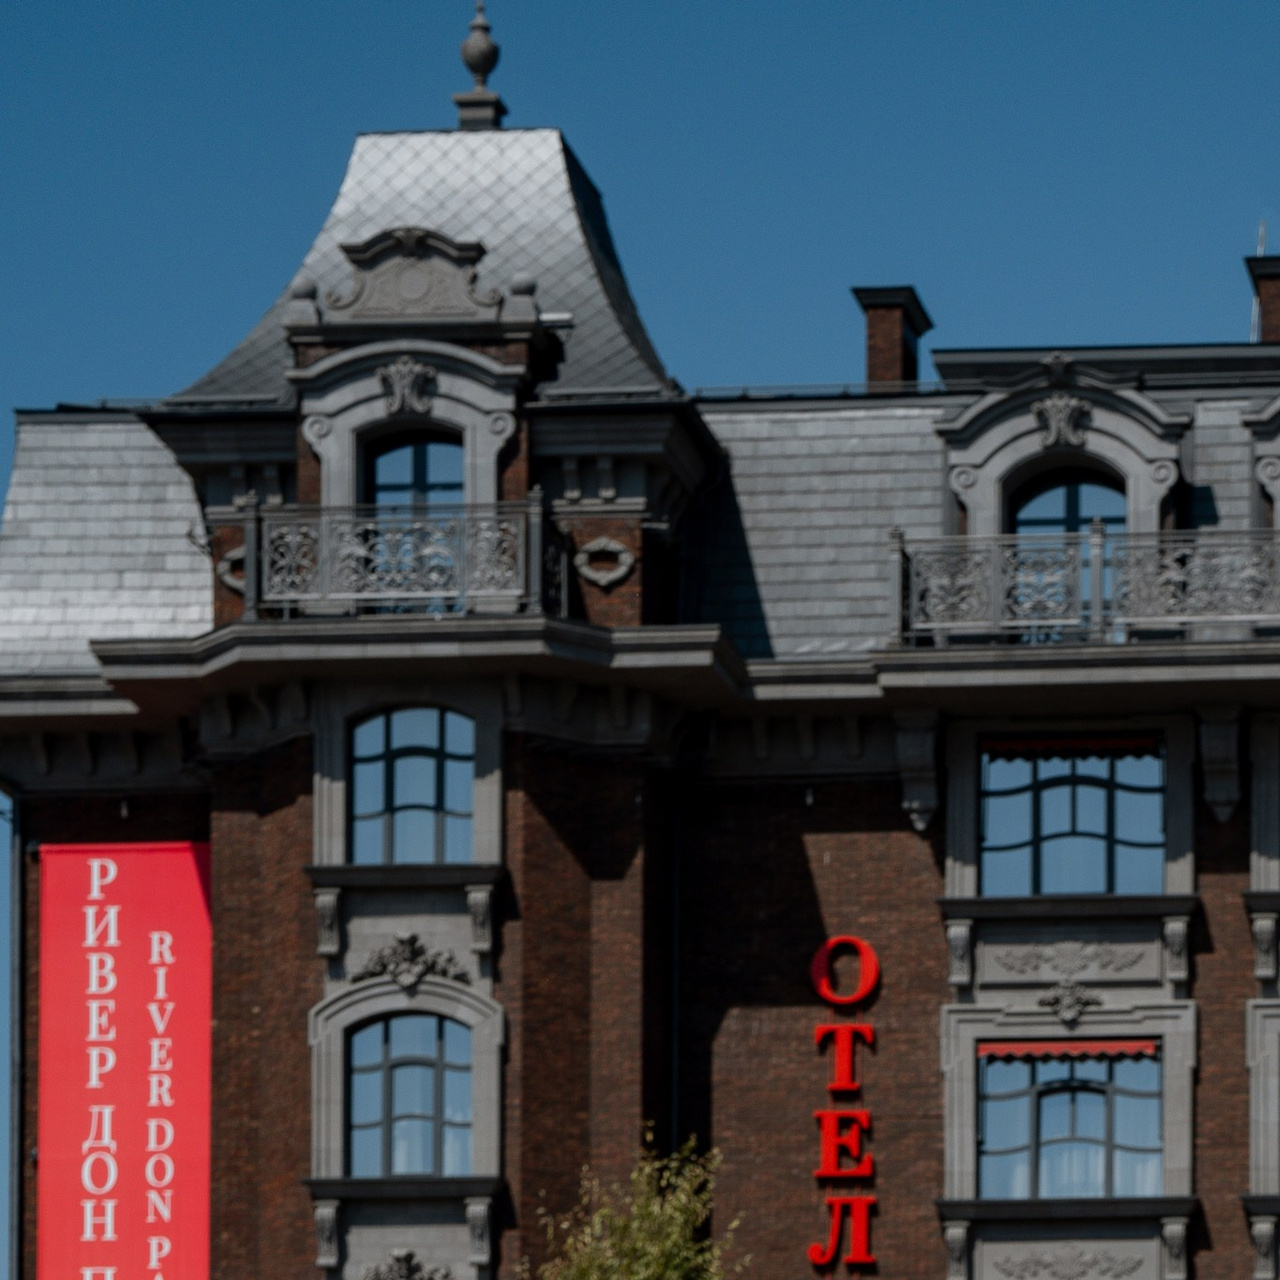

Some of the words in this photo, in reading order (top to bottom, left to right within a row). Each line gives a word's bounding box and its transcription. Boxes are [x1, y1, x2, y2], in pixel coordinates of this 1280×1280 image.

[83, 858, 120, 1089] РИВЕР
[147, 930, 176, 1107] RIVER
[81, 1105, 118, 1242] ДОН
[144, 1117, 175, 1223] DON
